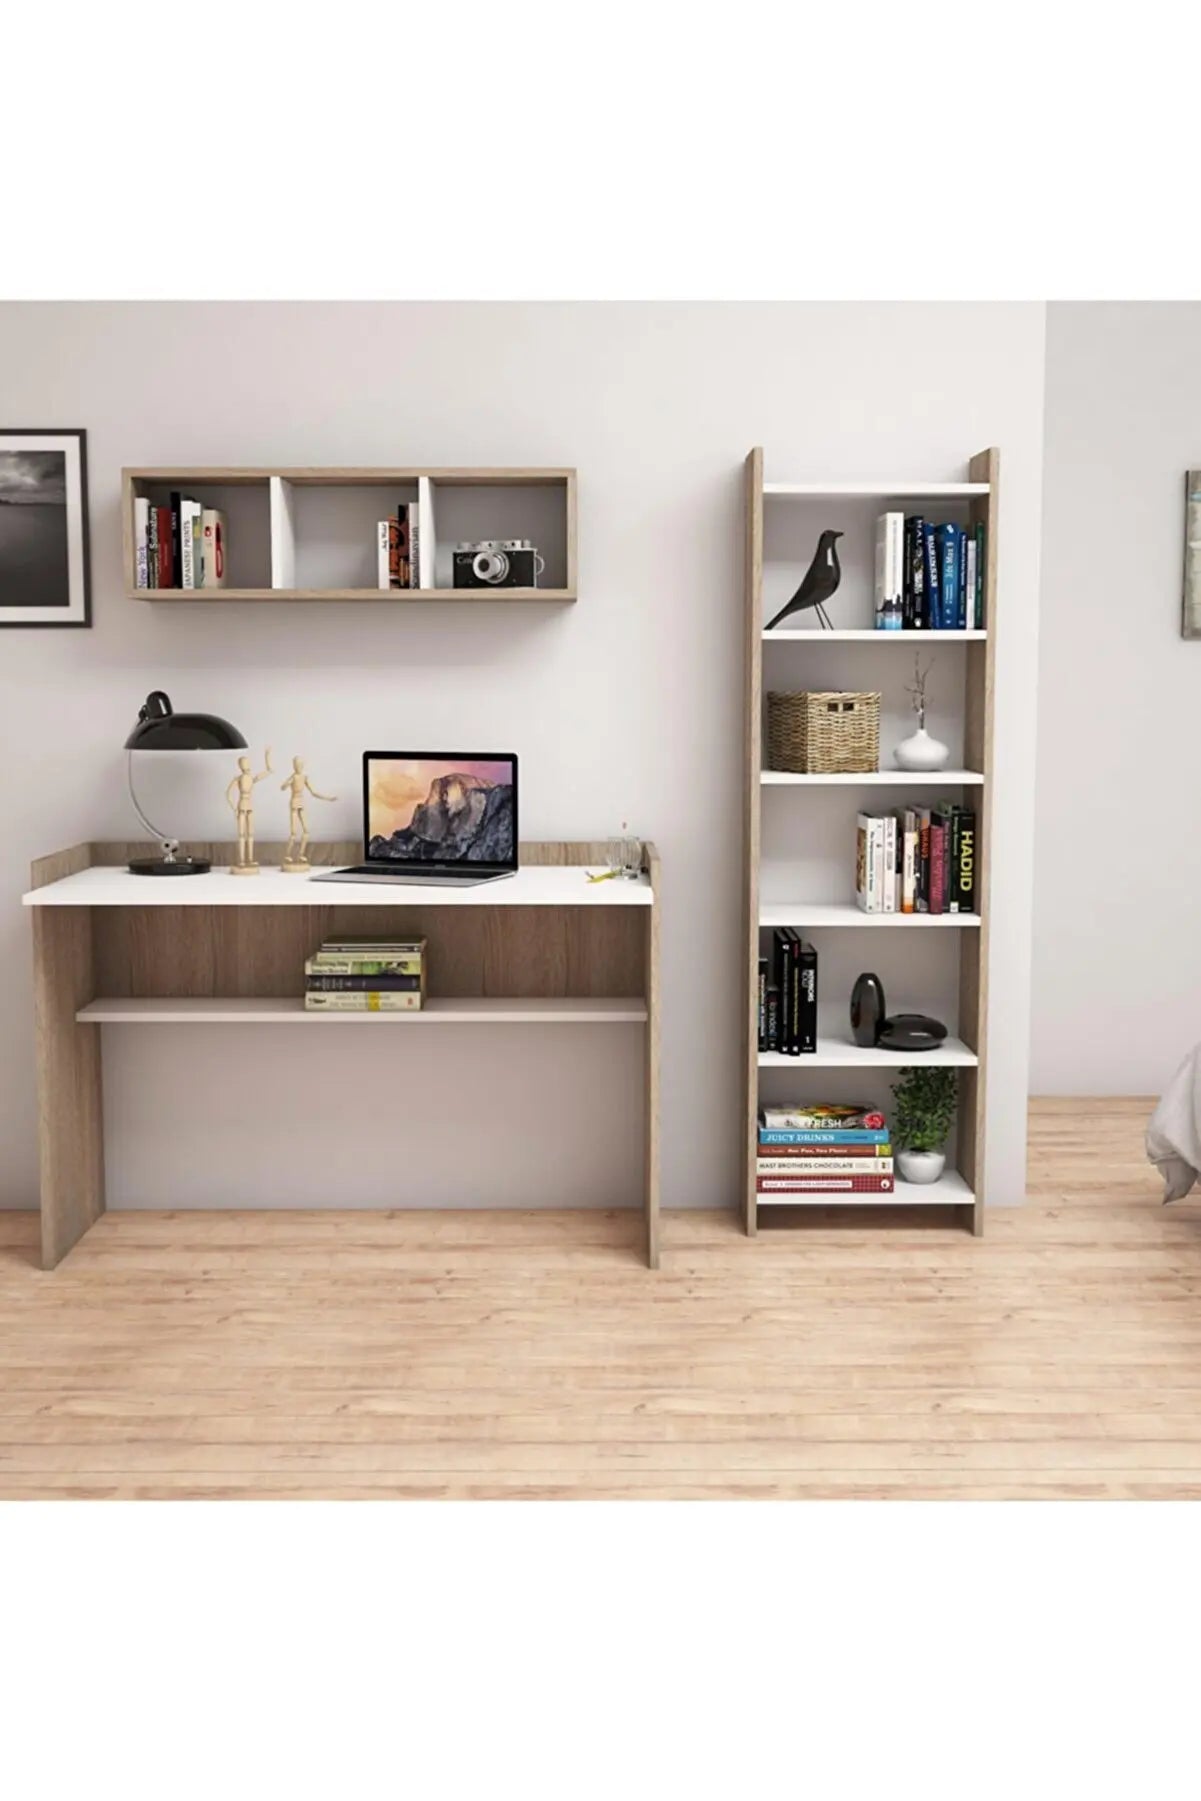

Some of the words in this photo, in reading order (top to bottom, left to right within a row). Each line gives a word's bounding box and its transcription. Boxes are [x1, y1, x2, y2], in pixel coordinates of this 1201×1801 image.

[183, 520, 191, 548] PRINTS
[138, 546, 147, 566] York
[184, 550, 192, 587] JAPANESE
[138, 567, 147, 589] New
[960, 831, 974, 892] HADID
[807, 969, 815, 1002] INTERIORS
[809, 1119, 842, 1129] FRESH
[766, 1133, 795, 1142] JUICY
[796, 1133, 835, 1142] DRINKS
